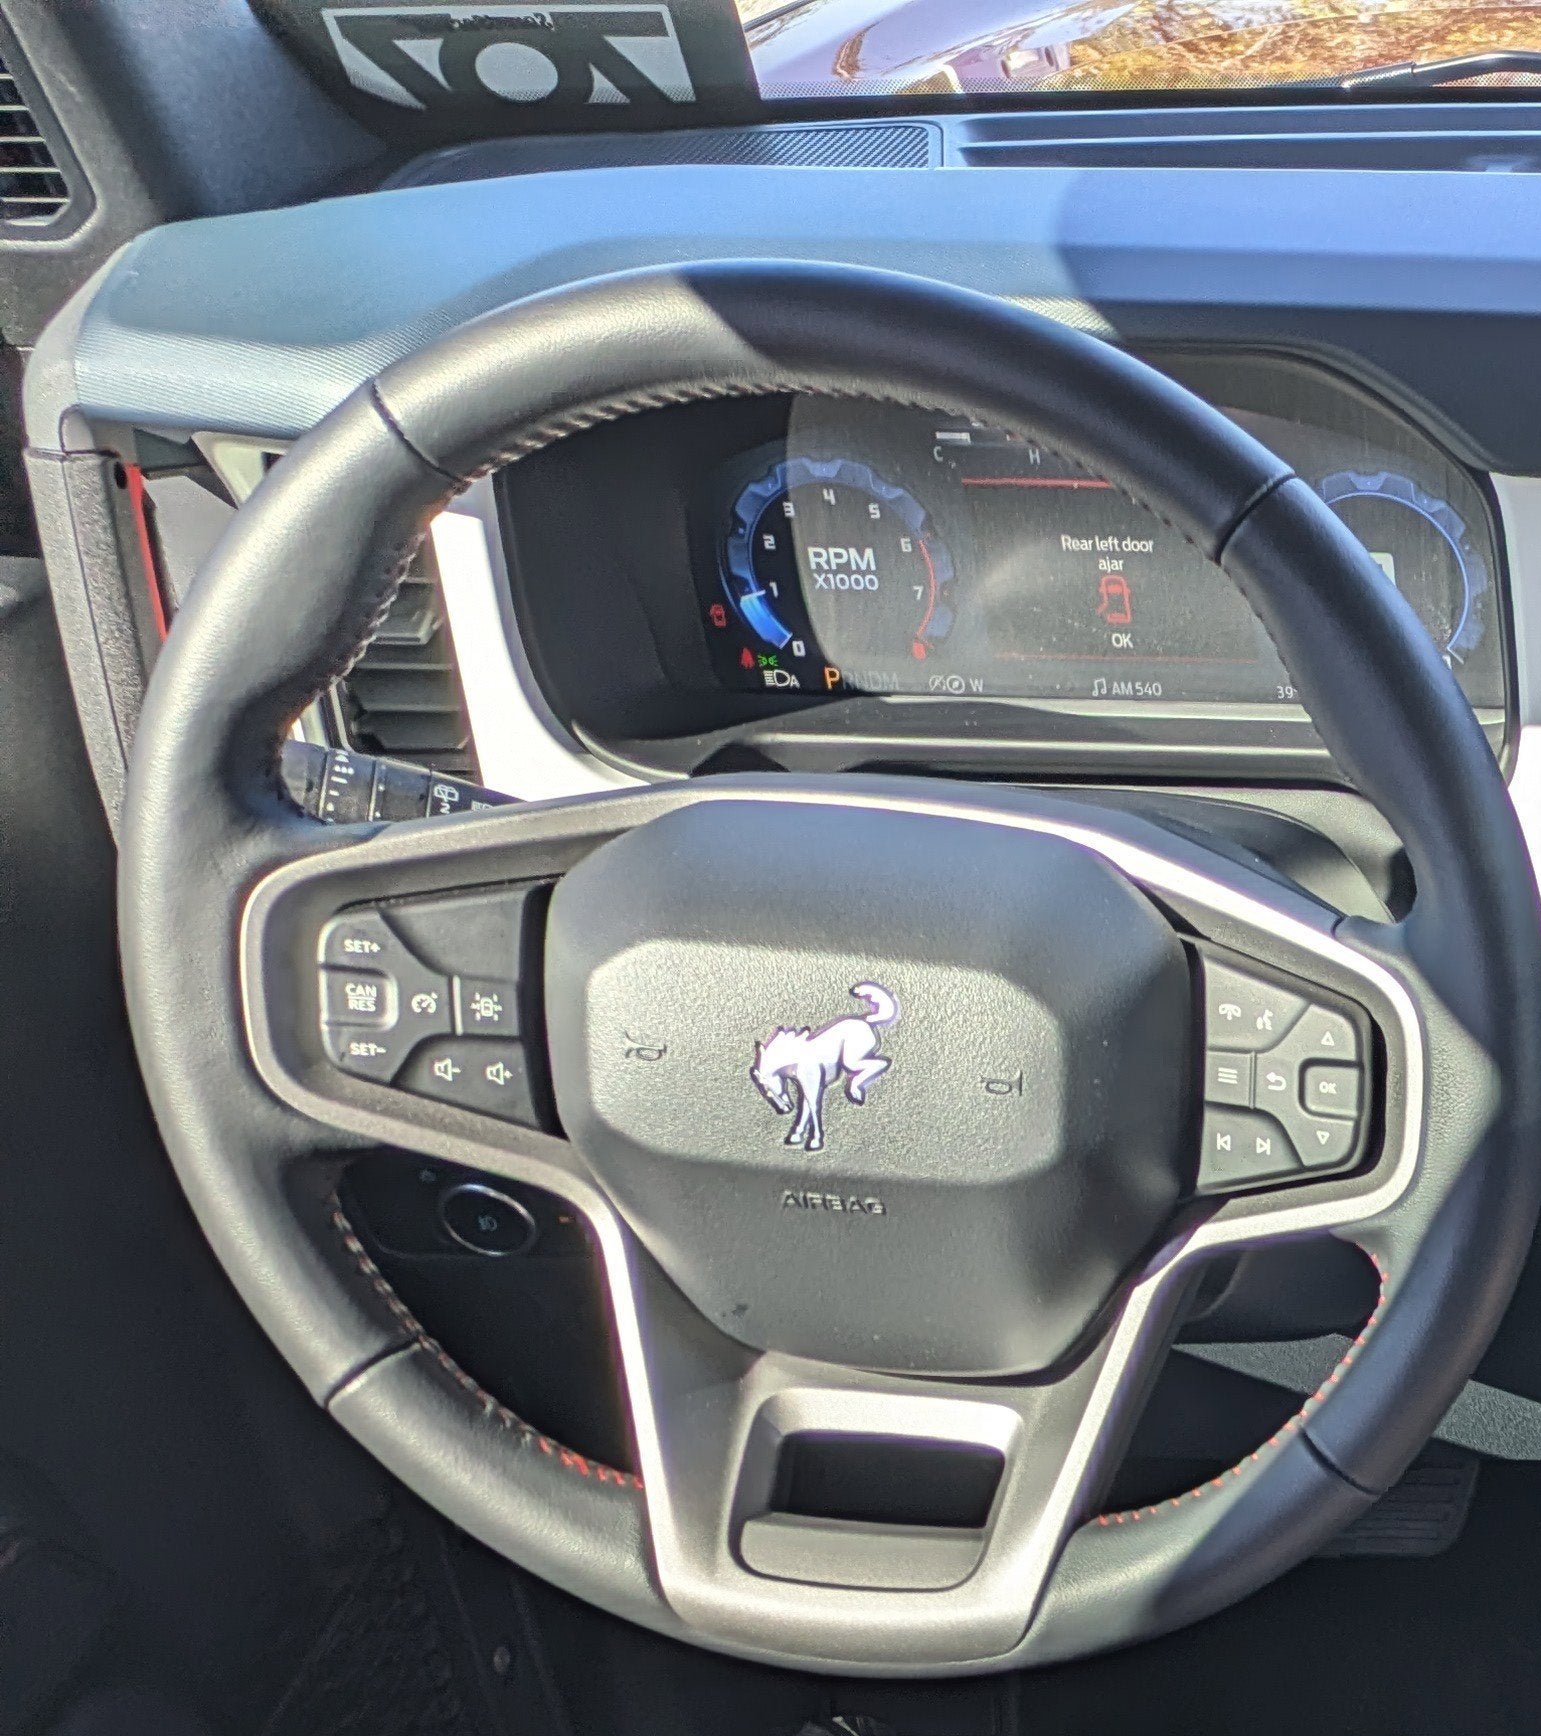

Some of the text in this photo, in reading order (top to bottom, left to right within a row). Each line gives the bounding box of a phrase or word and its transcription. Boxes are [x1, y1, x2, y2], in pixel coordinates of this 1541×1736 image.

[822, 489, 836, 506] 4
[783, 502, 796, 518] 3
[868, 504, 881, 520] 5
[763, 534, 776, 550] 2
[900, 538, 912, 553] 6
[1061, 534, 1154, 553] Rear left door
[807, 547, 876, 571] RPM
[1098, 556, 1124, 573] ajar
[769, 582, 779, 598] 1
[813, 573, 879, 591] X1000
[913, 586, 924, 600] 7
[792, 640, 806, 657] 0
[1111, 633, 1133, 649] OK
[970, 679, 984, 692] W
[1112, 682, 1162, 697] AM 540
[346, 985, 377, 998] CAN
[349, 999, 376, 1012] RES
[1319, 1082, 1337, 1095] OK
[783, 1189, 887, 1216] AIRBAG
